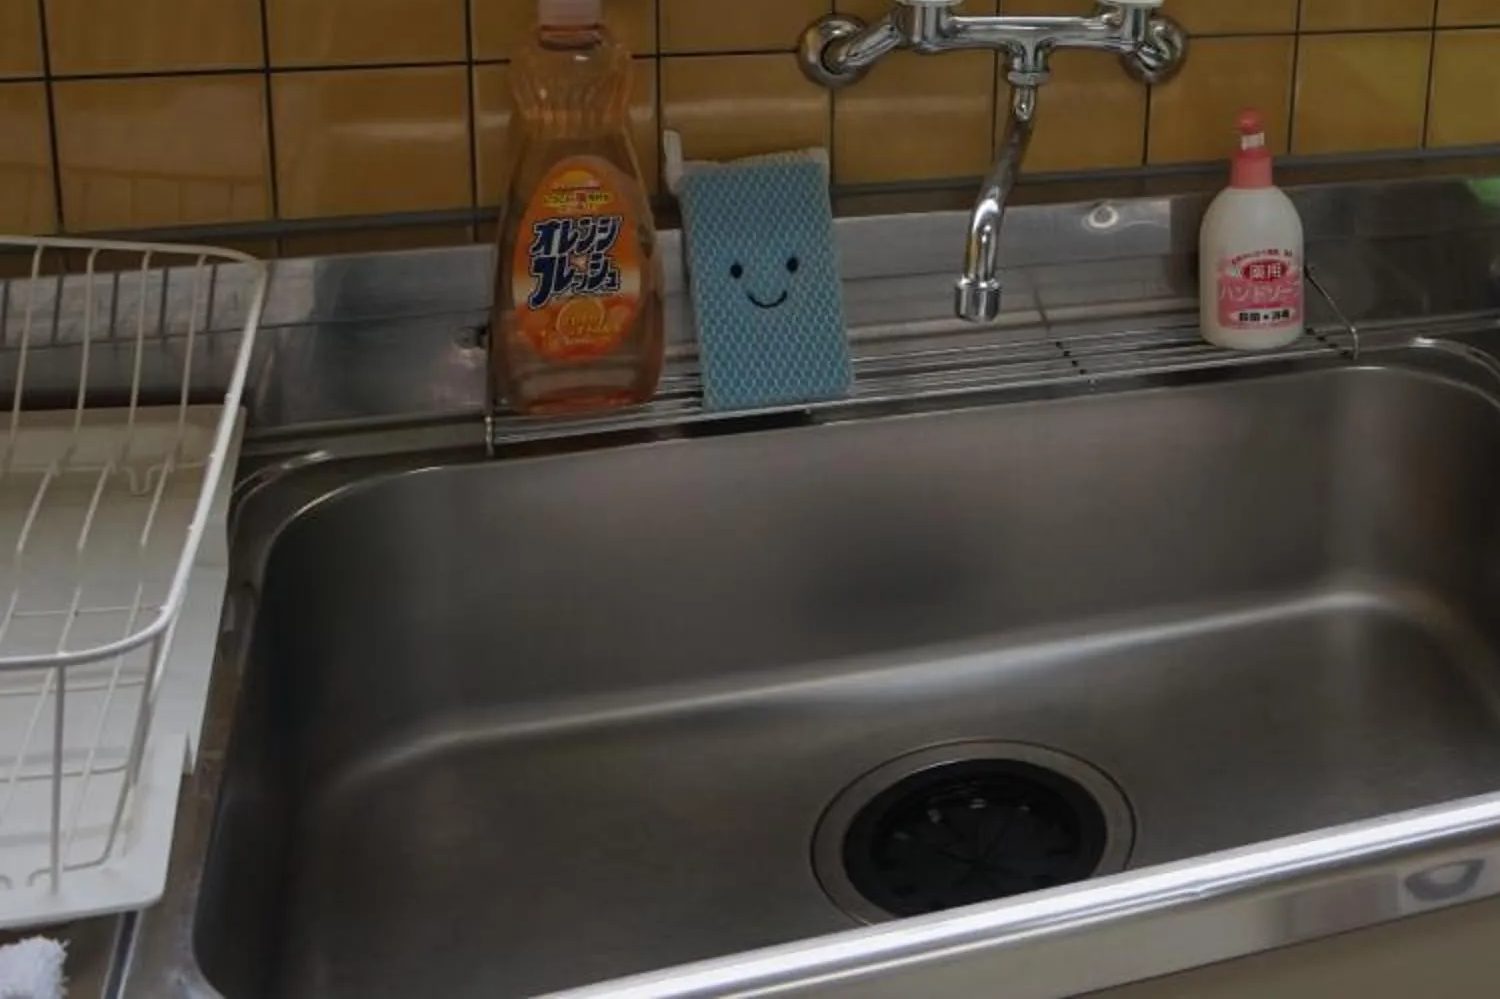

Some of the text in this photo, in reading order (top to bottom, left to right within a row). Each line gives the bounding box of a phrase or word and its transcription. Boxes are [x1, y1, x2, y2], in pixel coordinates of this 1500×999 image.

[531, 216, 622, 255] オレンジ
[528, 251, 621, 308] フレッシュ
